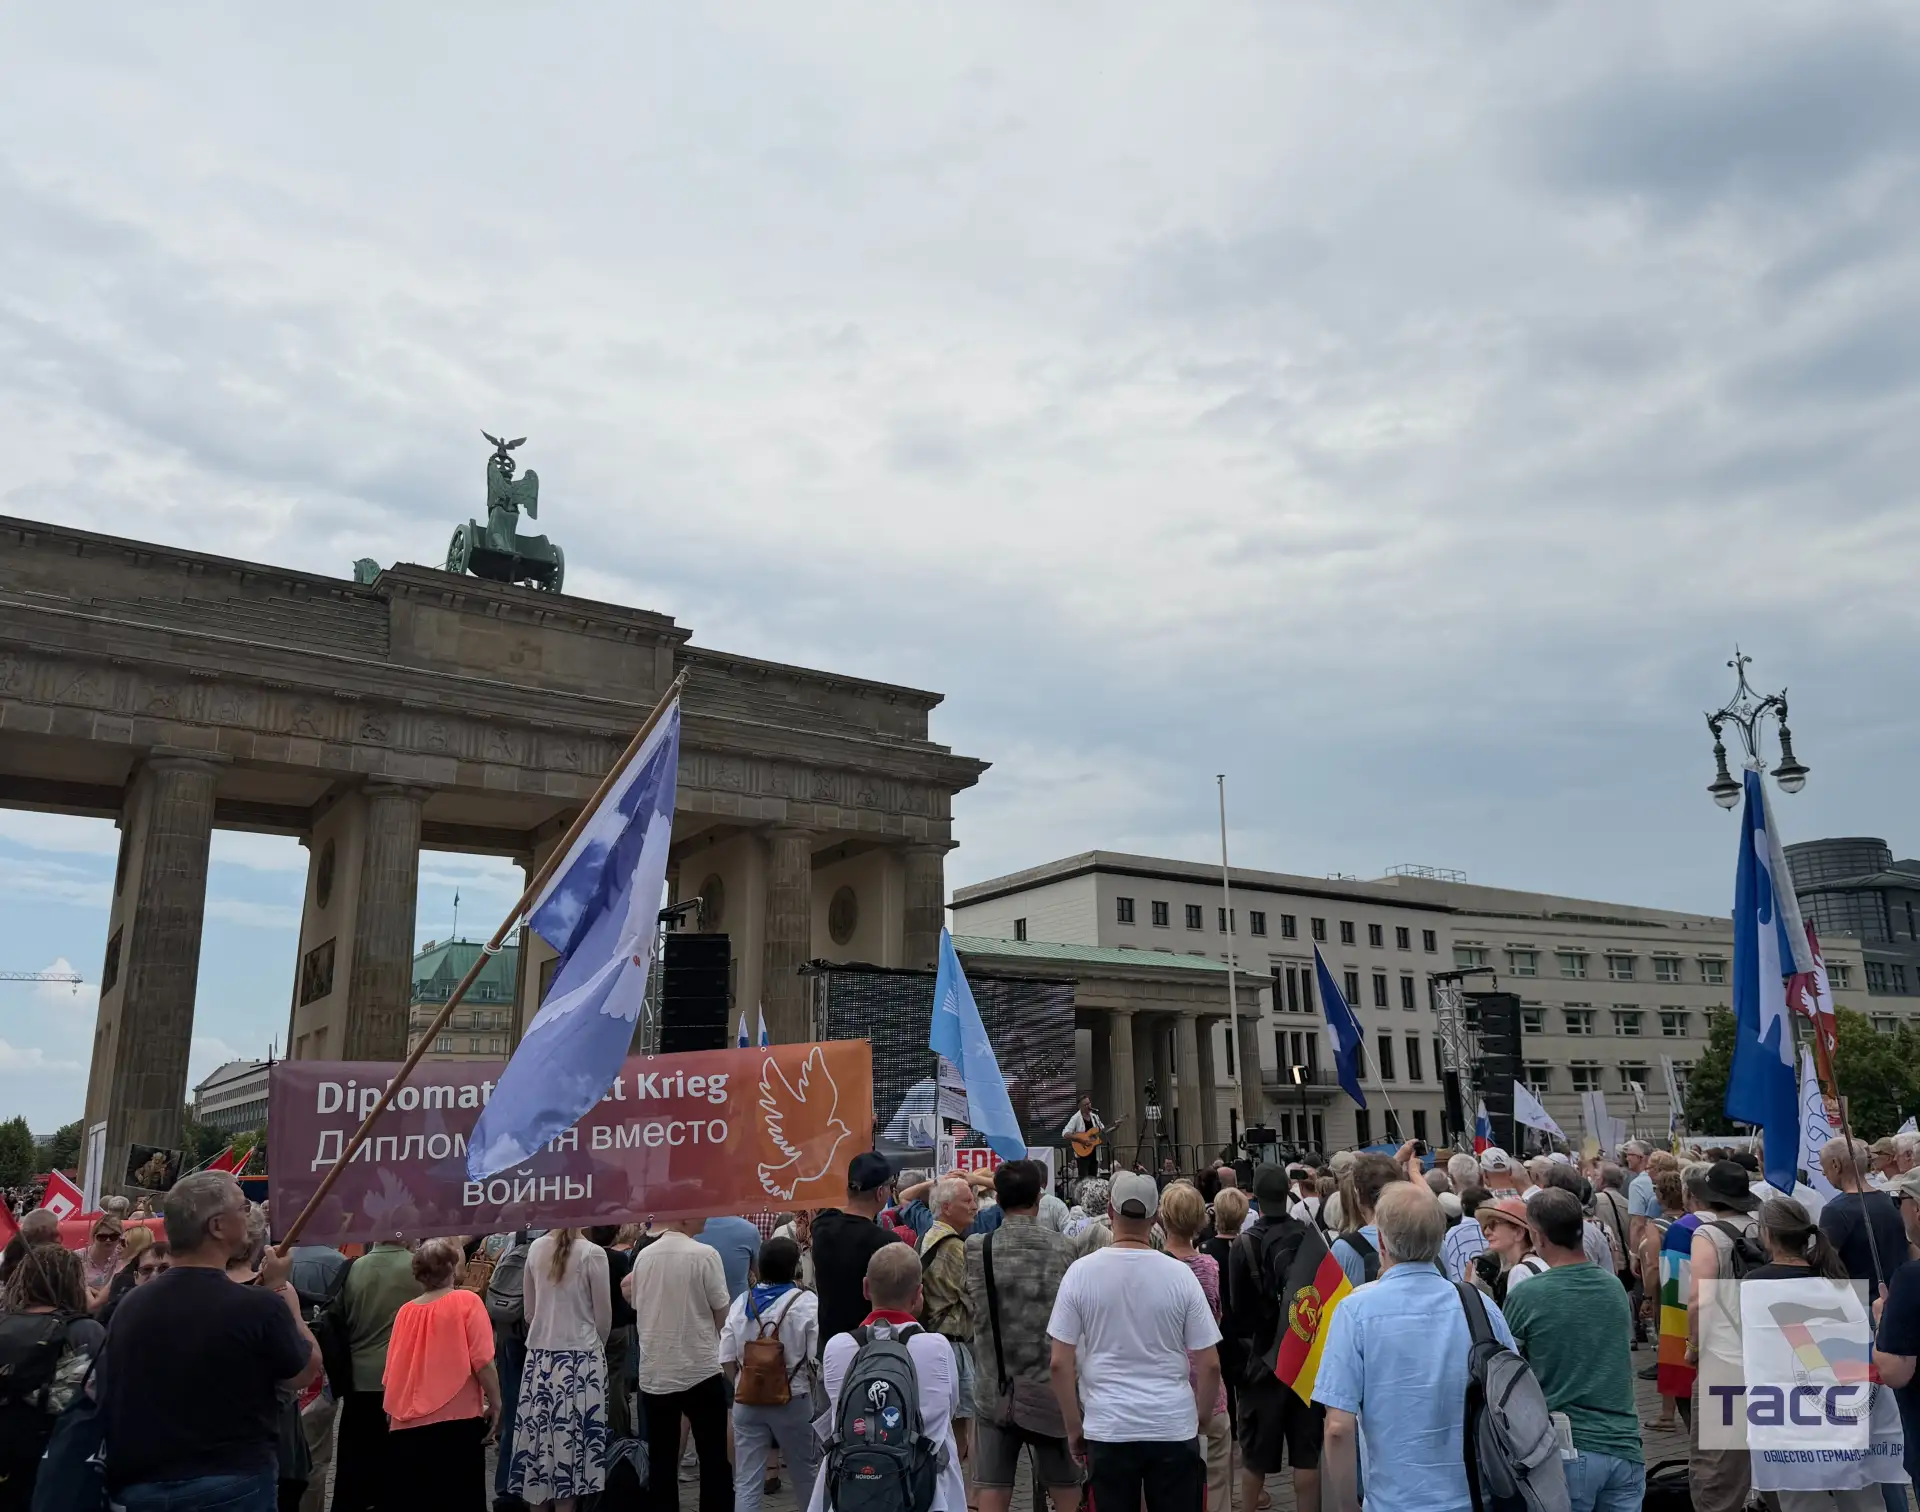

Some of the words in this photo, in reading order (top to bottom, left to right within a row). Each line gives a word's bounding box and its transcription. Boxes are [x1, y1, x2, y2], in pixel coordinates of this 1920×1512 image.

[638, 1069, 729, 1103] Krieg
[591, 1119, 728, 1150] вместо
[463, 1168, 592, 1207] войны
[1764, 1450, 1814, 1464] ОБЩЕСТВО
